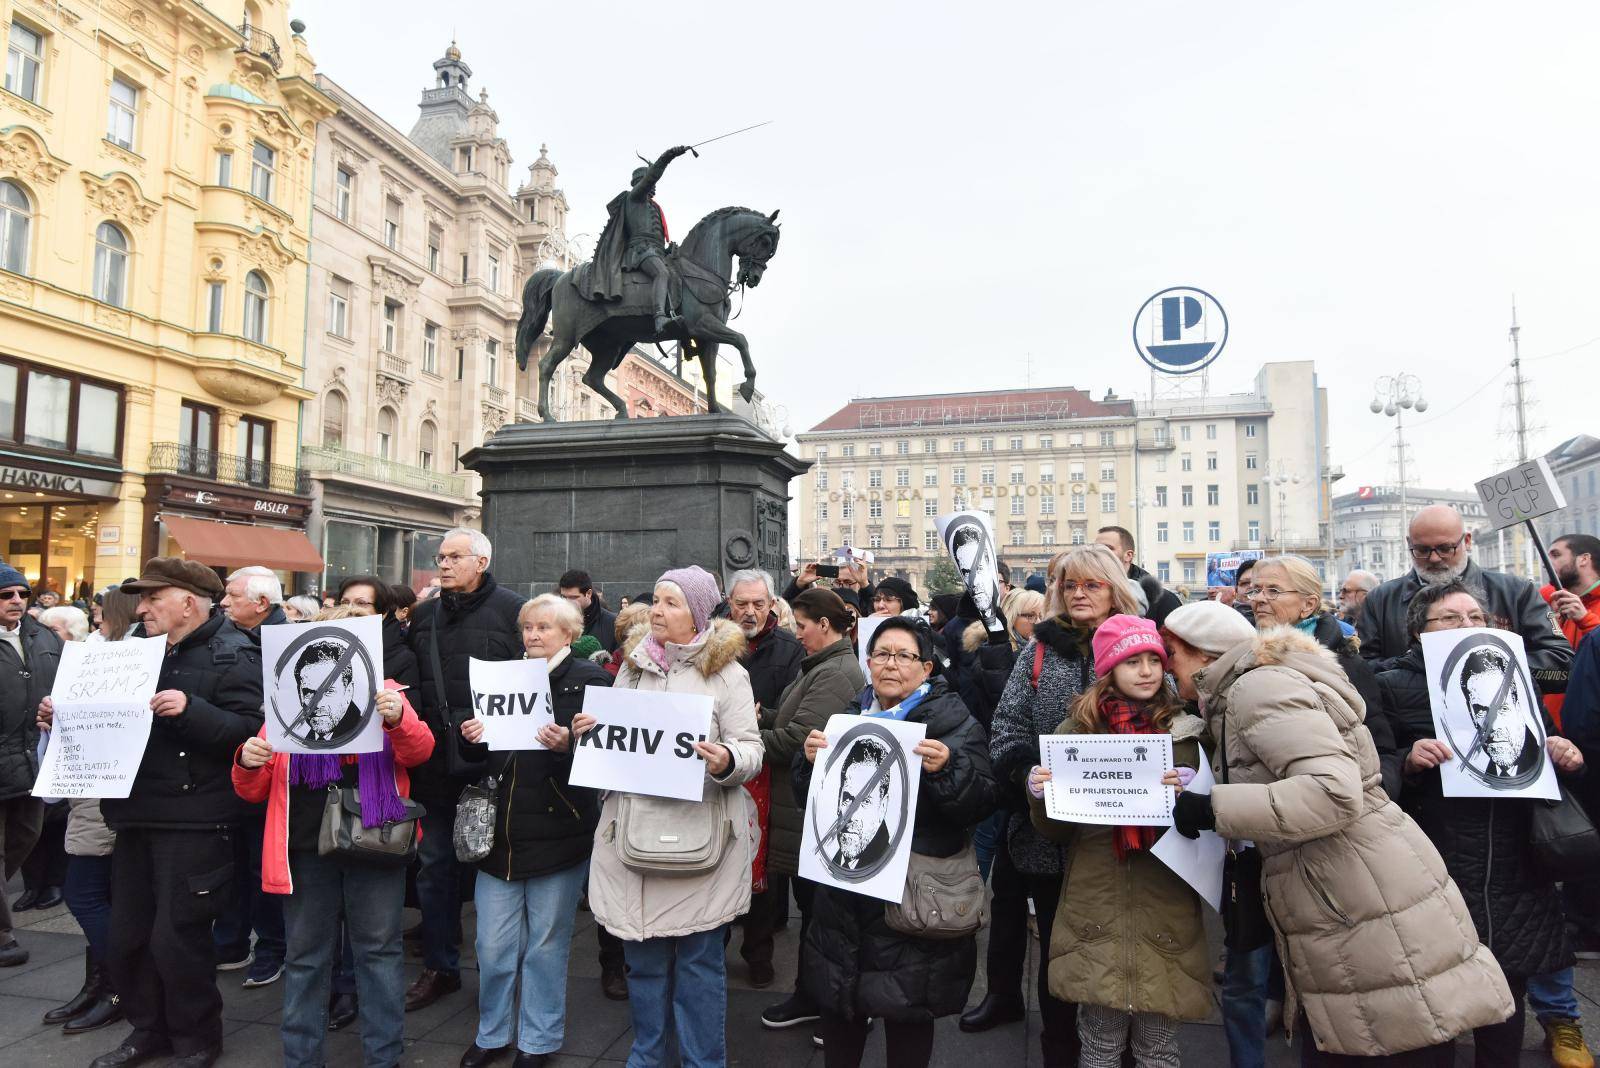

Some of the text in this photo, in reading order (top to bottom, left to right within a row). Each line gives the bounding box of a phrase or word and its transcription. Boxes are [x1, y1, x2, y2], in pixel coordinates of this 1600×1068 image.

[2, 468, 84, 493] HARMICA
[1480, 468, 1541, 502] DOLJE
[254, 500, 289, 514] BASLER
[1498, 490, 1538, 519] GUP
[472, 689, 538, 716] KRIV
[580, 723, 665, 755] KRIV
[1082, 771, 1133, 780] ZAGREB
